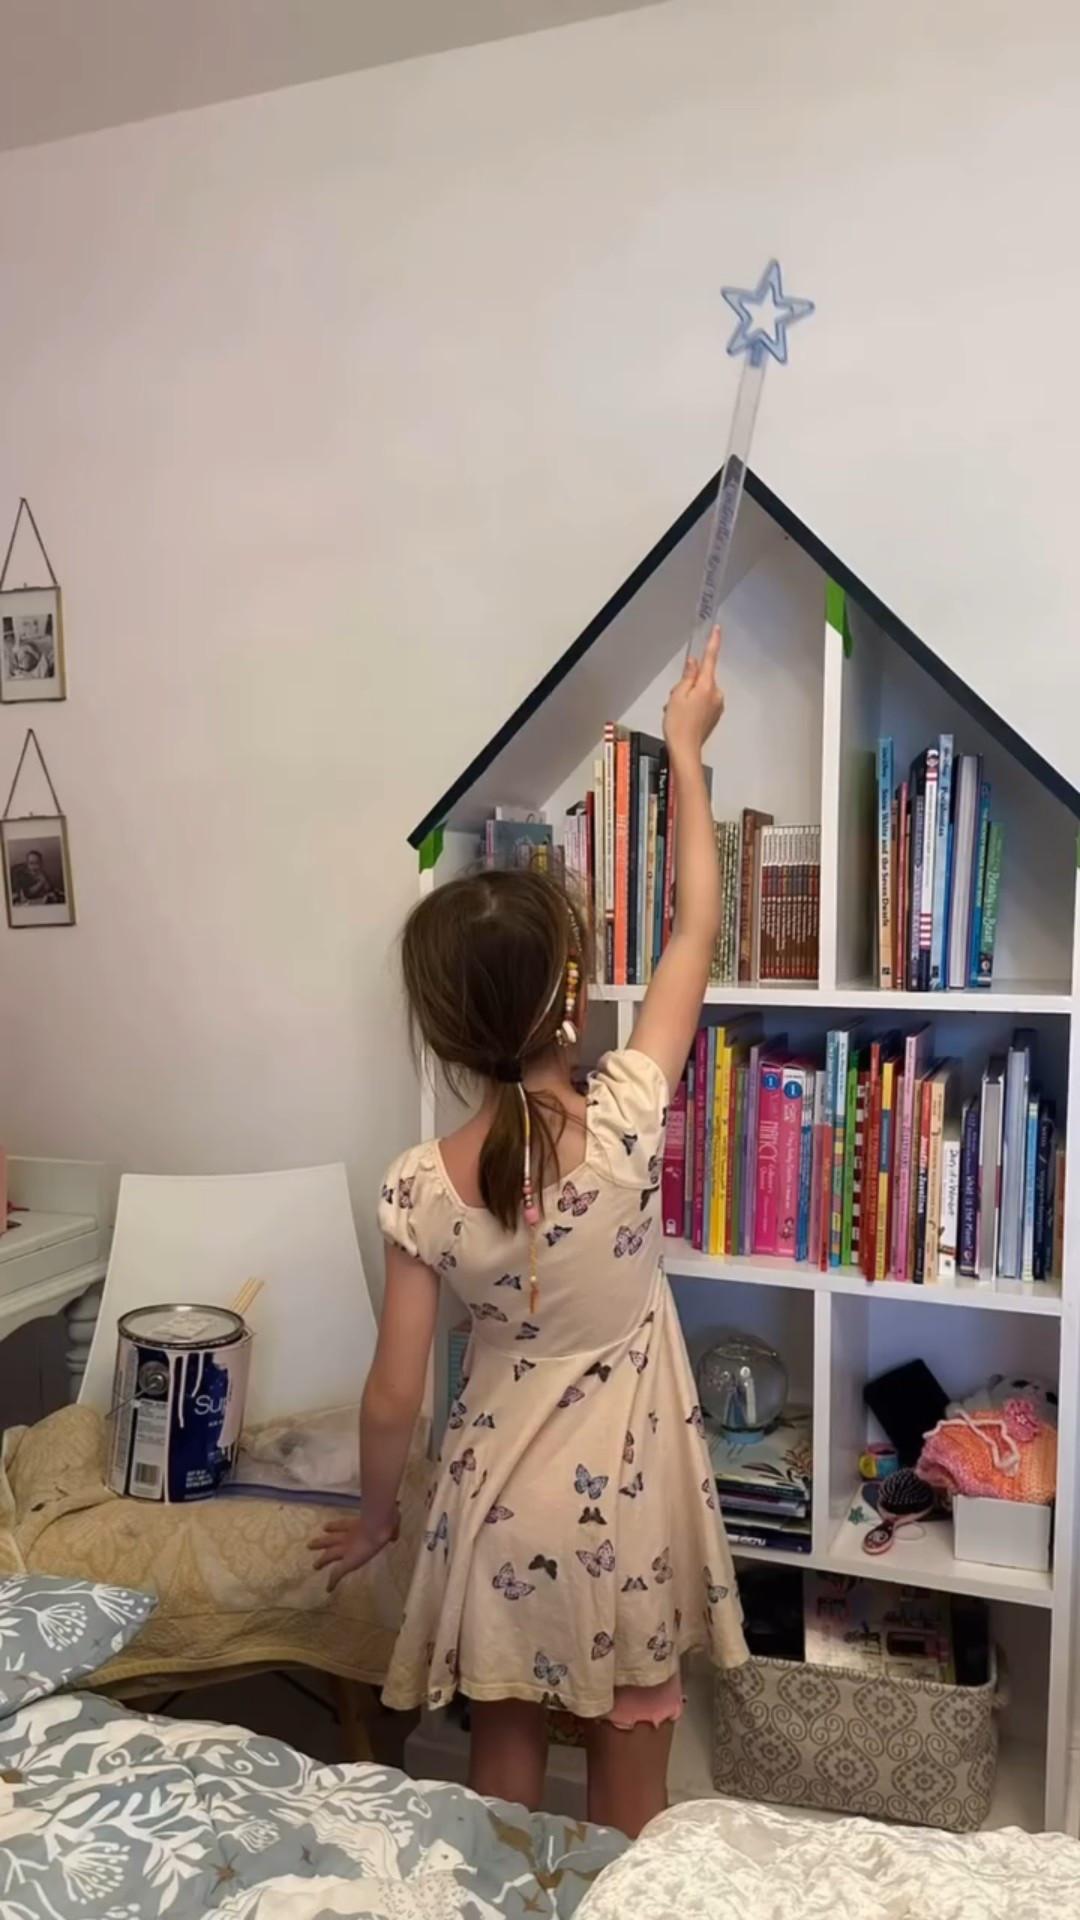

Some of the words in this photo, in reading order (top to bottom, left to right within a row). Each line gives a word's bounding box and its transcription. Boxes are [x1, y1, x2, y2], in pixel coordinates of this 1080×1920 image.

[698, 590, 714, 622] Table
[881, 787, 889, 811] Snow
[937, 785, 948, 837] Pocahontas
[881, 811, 889, 837] White
[881, 872, 889, 897] Seven
[985, 869, 1000, 903] Beauty
[881, 897, 889, 926] Dwarfs
[983, 916, 997, 944] Beast
[757, 1119, 779, 1162] NANCY
[917, 1134, 929, 1174] Josefina
[916, 1174, 926, 1214] Javelina
[965, 1175, 975, 1195] What
[964, 1207, 974, 1221] the
[963, 1222, 974, 1249] Moon?
